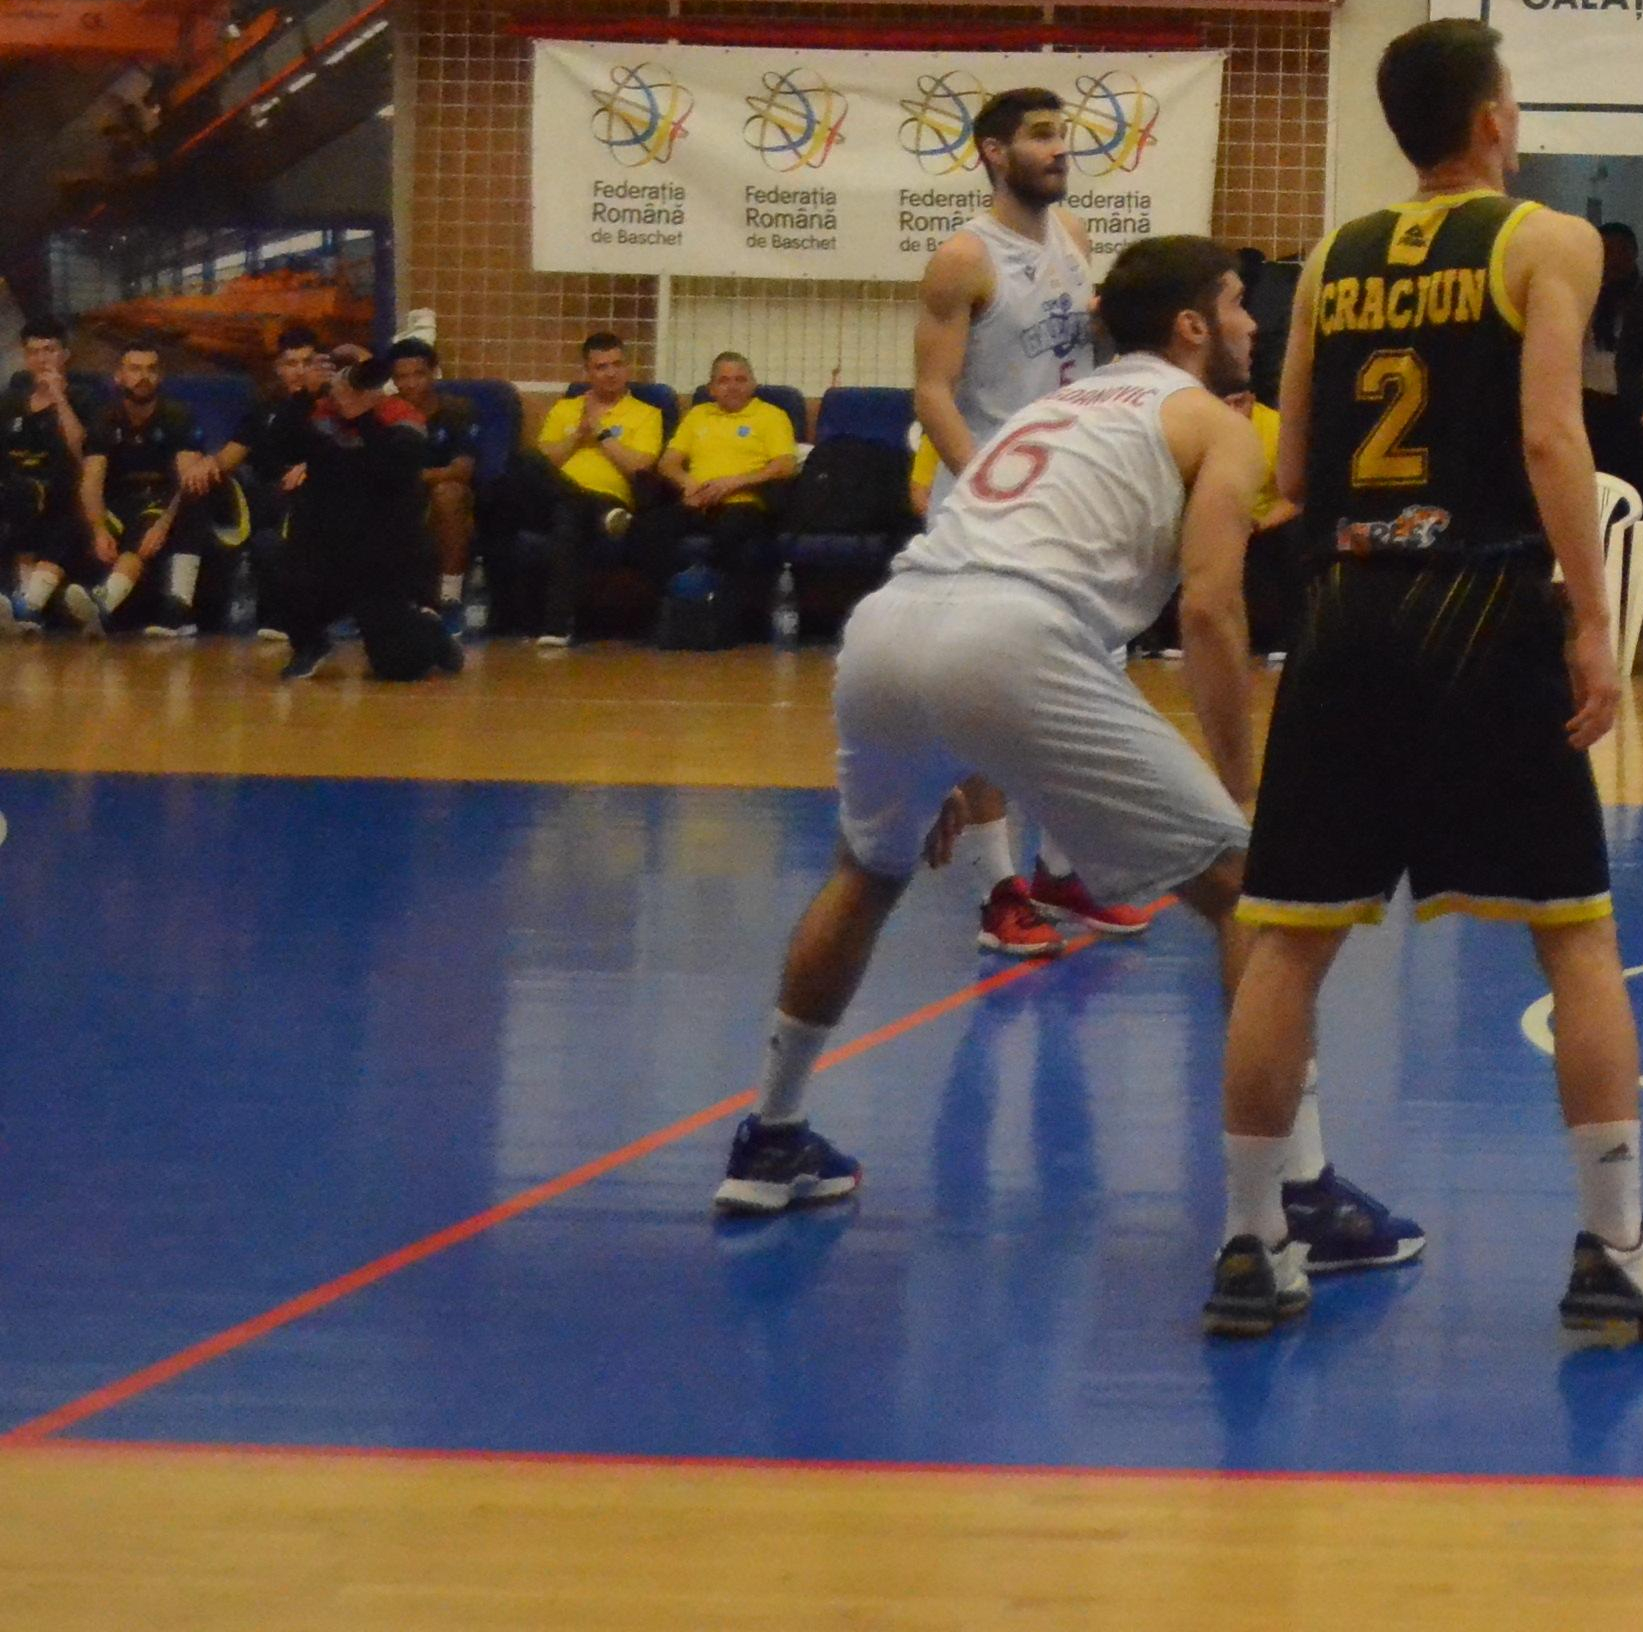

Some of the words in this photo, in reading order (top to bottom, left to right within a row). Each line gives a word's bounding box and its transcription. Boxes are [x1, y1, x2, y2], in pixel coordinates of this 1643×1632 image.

[592, 181, 686, 204] Federația
[745, 186, 837, 209] Federația
[900, 188, 993, 213] Federația
[591, 202, 685, 225] Română
[745, 208, 838, 230] Română
[591, 229, 612, 245] de
[617, 230, 684, 246] Baschet
[746, 234, 767, 248] de
[771, 234, 837, 250] Baschet
[900, 237, 921, 253] de
[1352, 347, 1429, 487] 2
[969, 414, 1079, 504] 6
